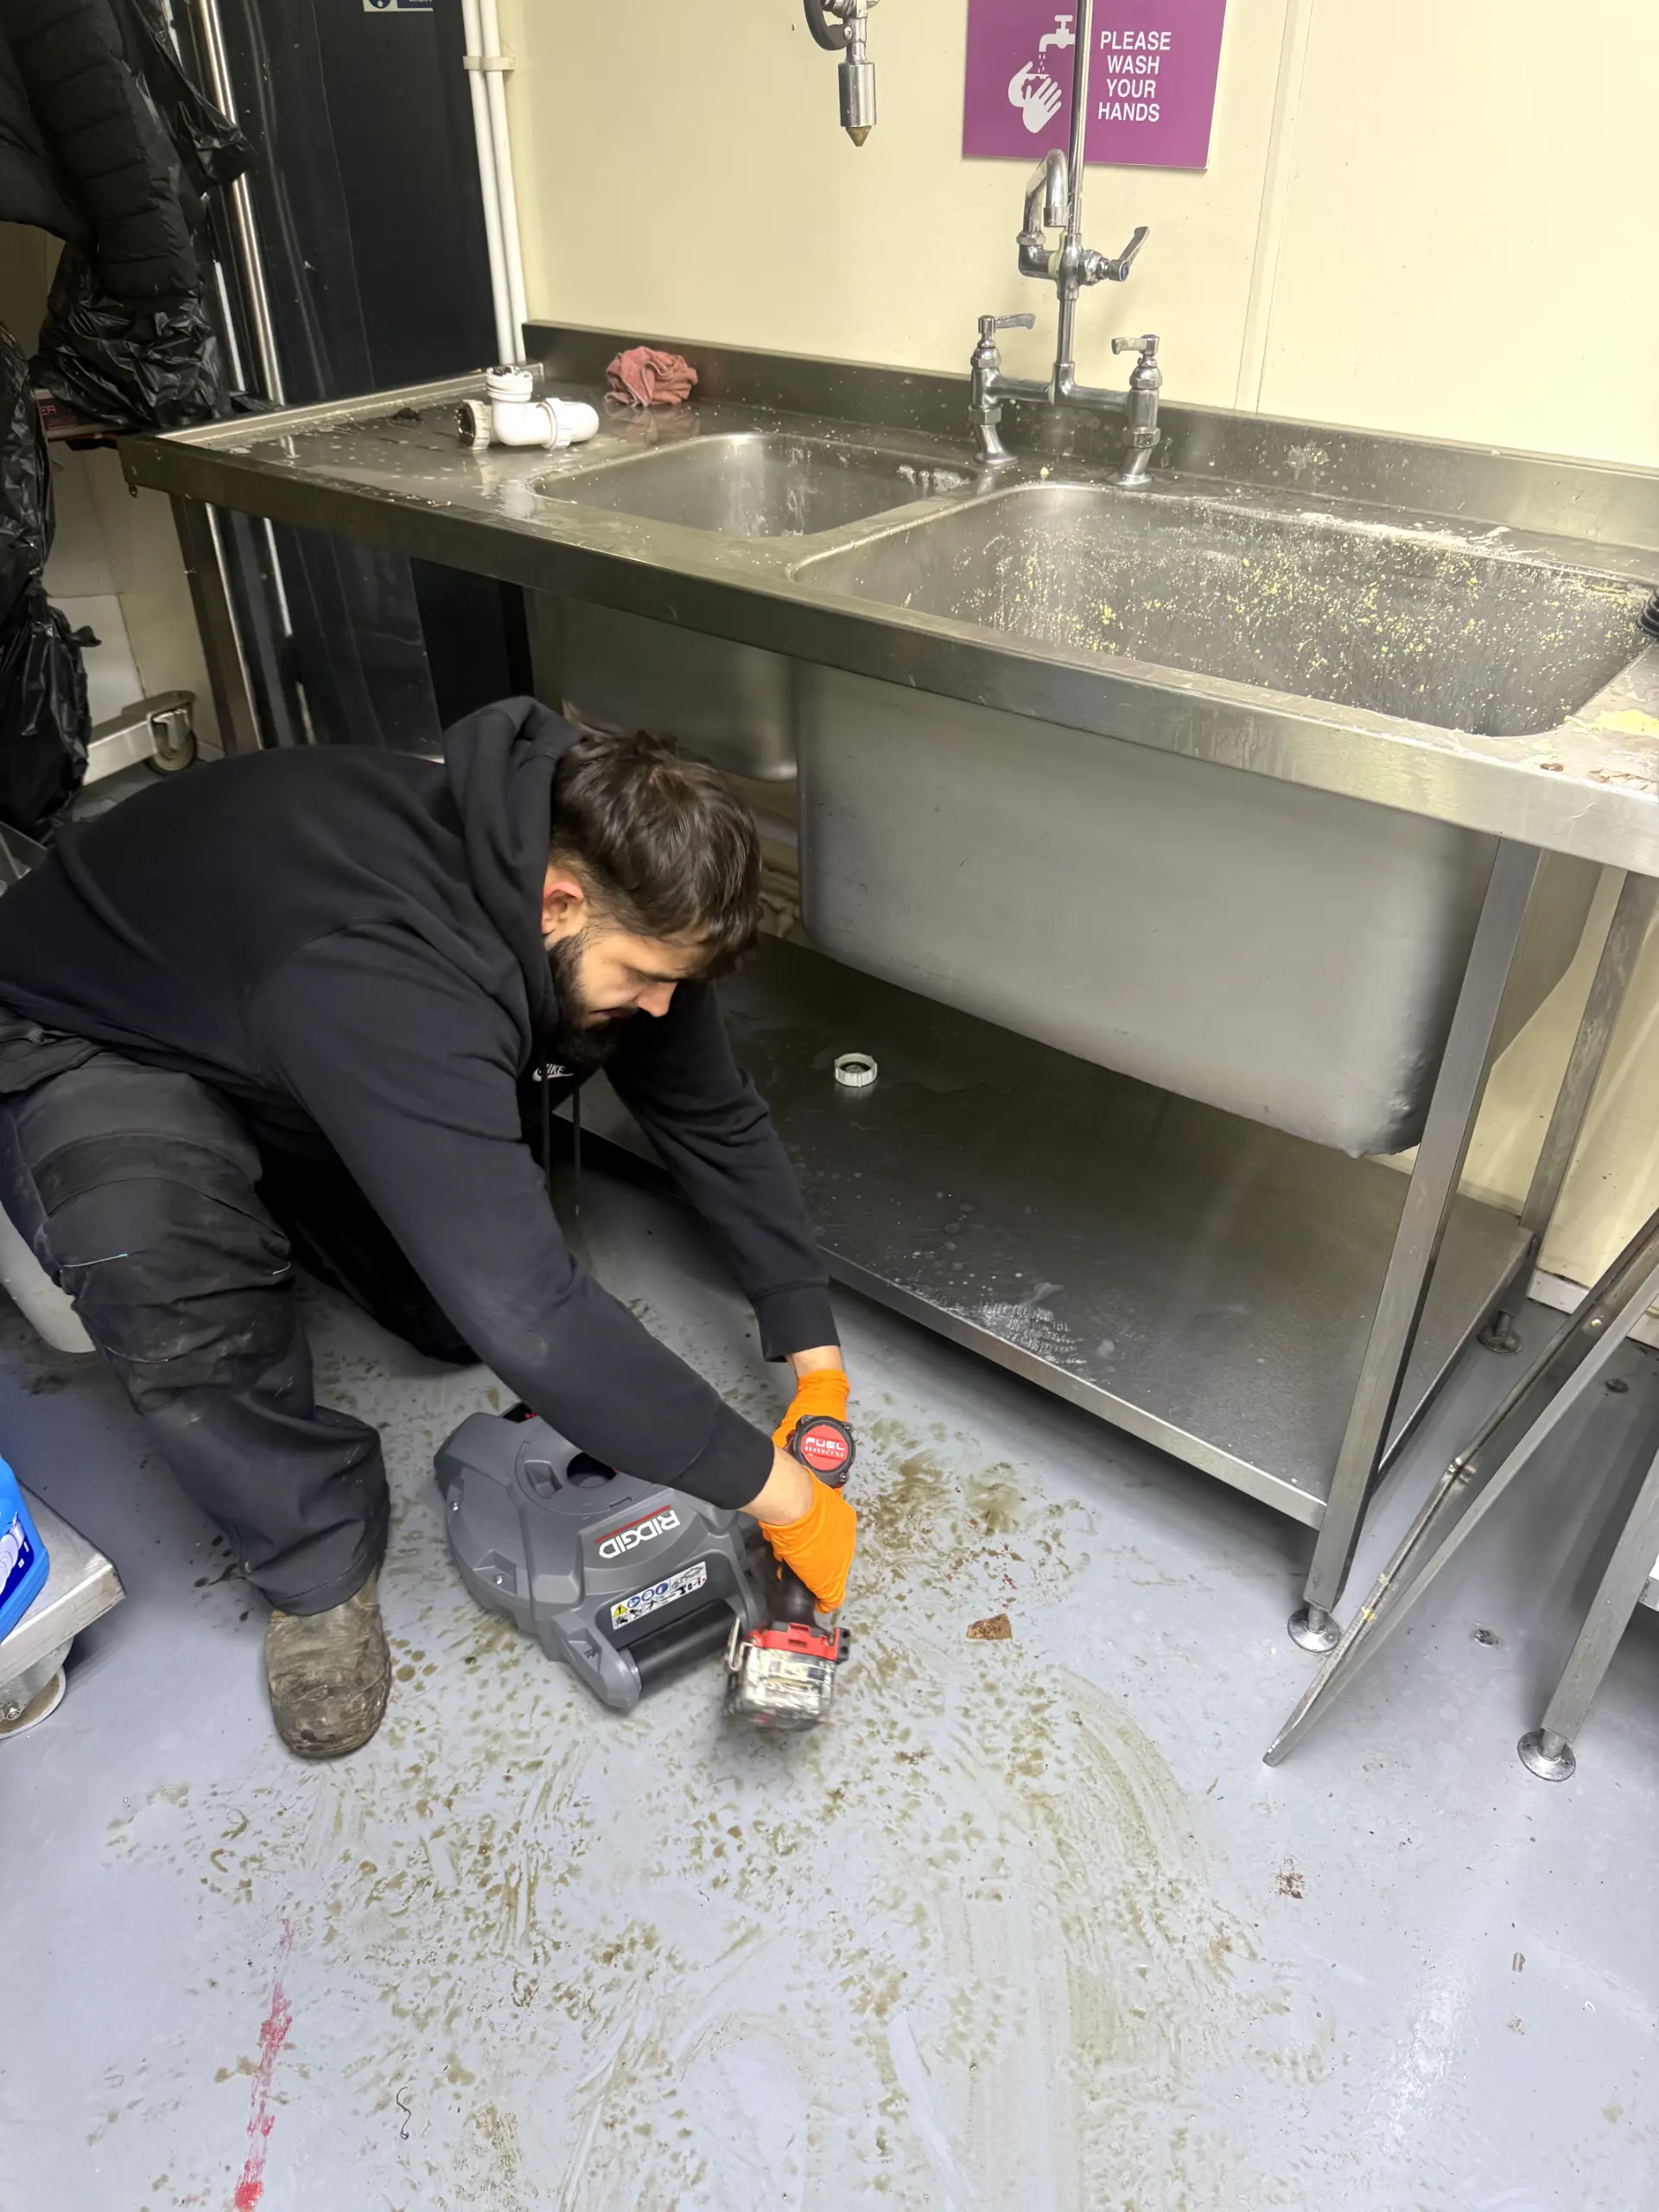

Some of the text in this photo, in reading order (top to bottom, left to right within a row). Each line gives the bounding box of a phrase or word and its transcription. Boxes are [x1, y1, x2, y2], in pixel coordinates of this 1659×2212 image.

[1100, 30, 1172, 51] PLEASE
[1107, 54, 1160, 74] WASH
[1106, 78, 1156, 99] YOUR
[1097, 101, 1160, 123] HANDS
[805, 1437, 845, 1452] FUEL
[599, 1510, 681, 1559] RIDGID
